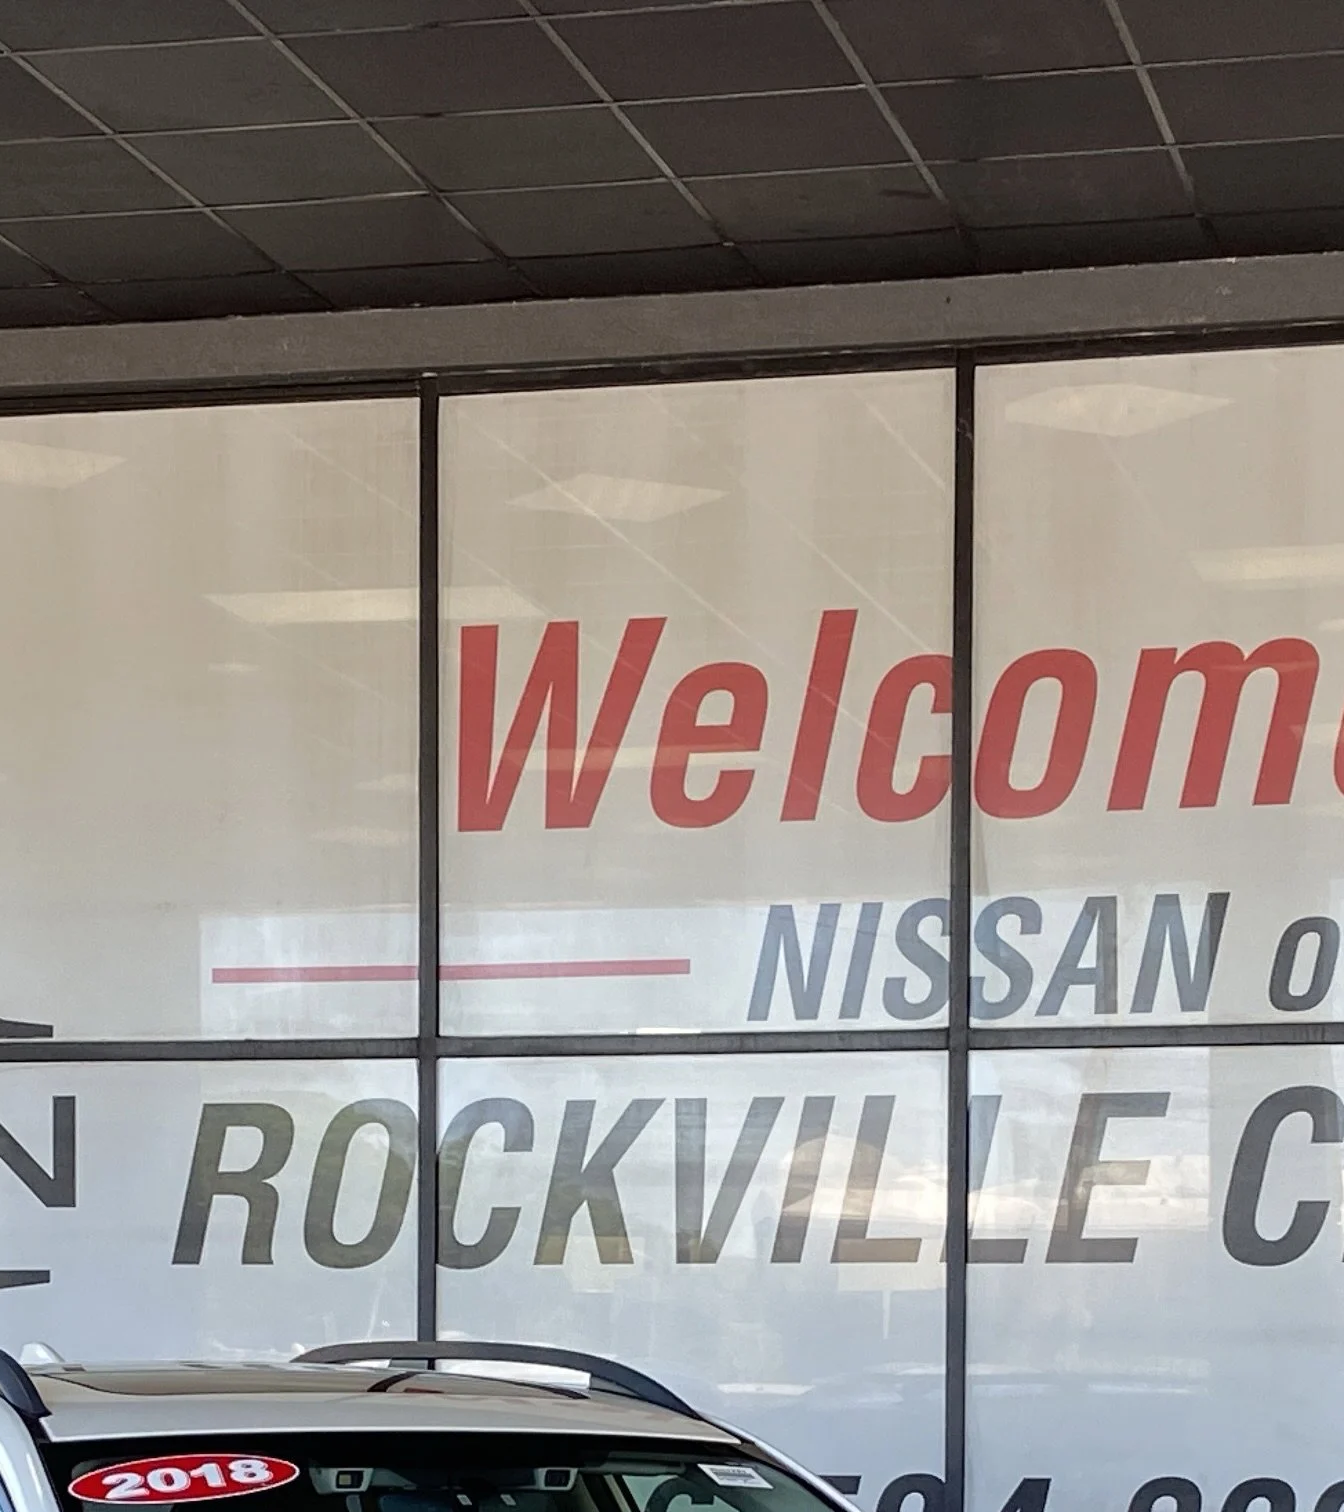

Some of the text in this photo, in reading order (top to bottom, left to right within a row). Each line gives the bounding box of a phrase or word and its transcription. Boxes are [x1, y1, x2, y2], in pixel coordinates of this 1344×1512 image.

[747, 891, 1230, 1021] NISSAN
[171, 1092, 1170, 1269] ROCKVILLE
[102, 1459, 274, 1499] 2018
